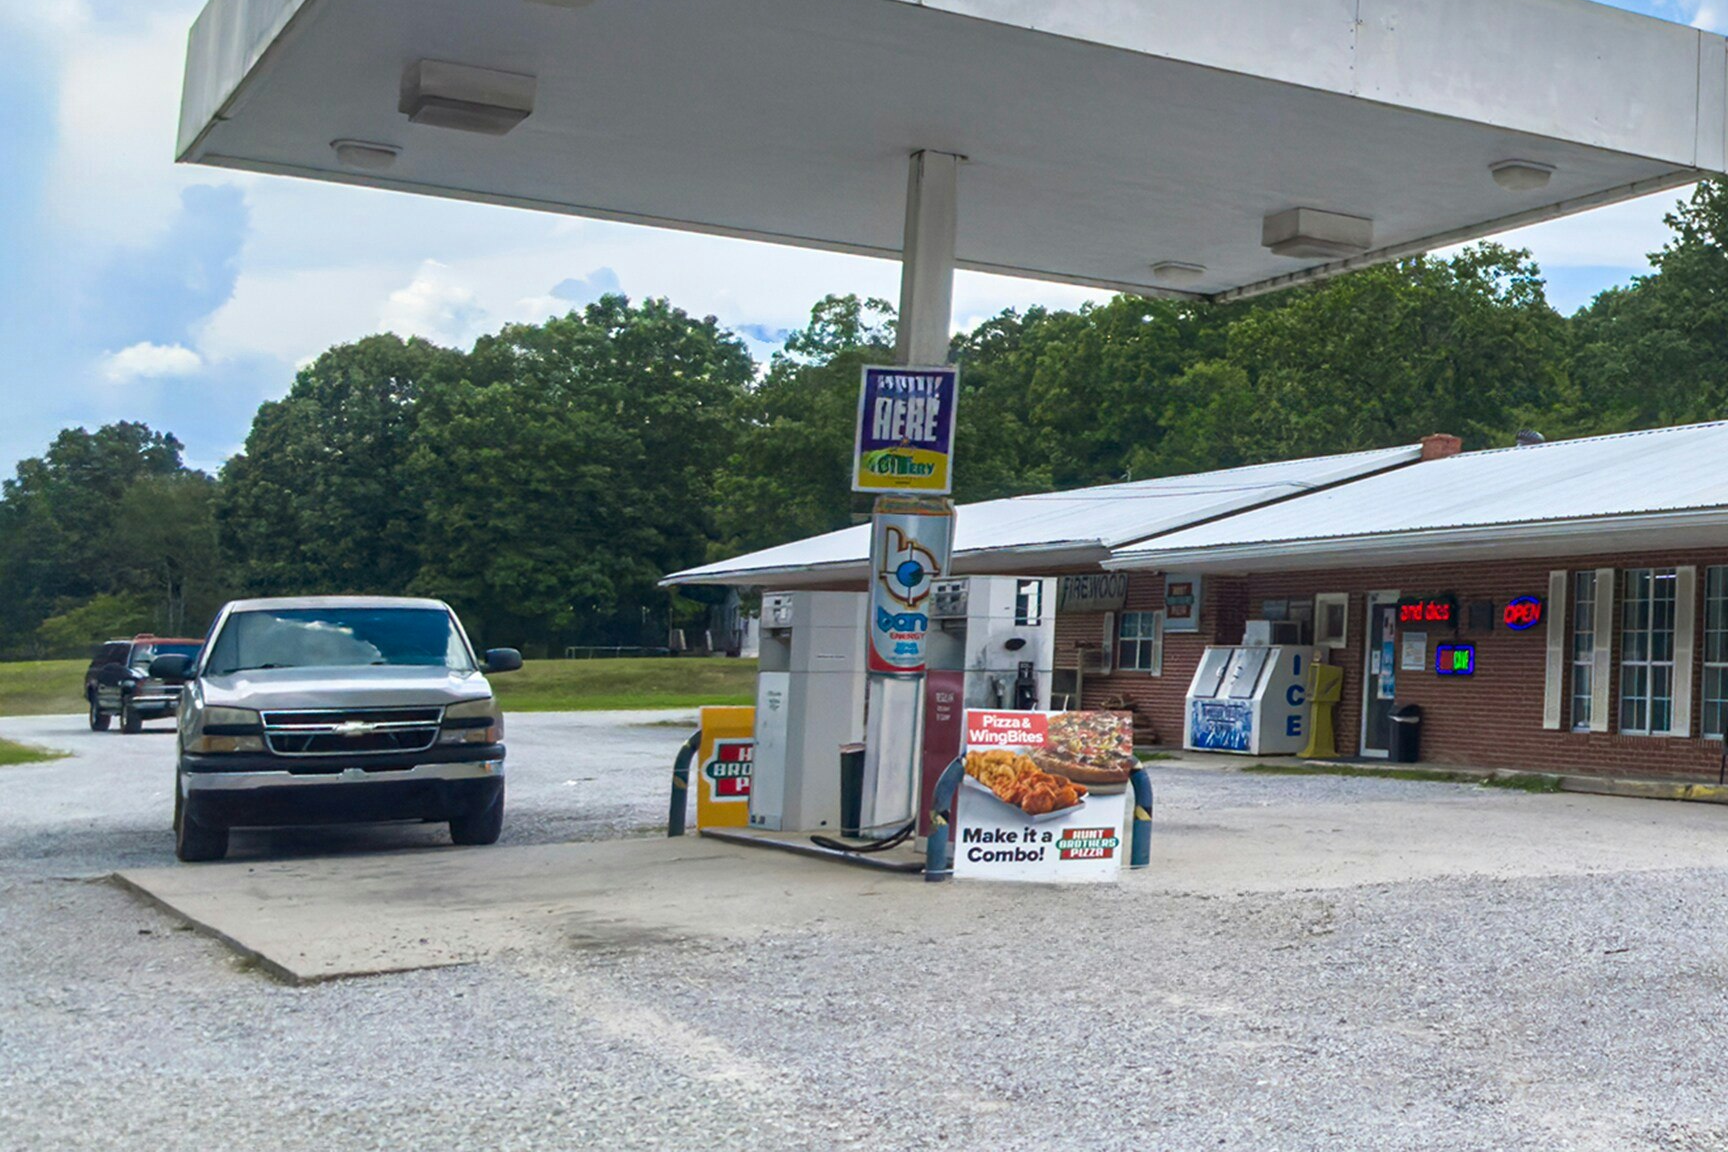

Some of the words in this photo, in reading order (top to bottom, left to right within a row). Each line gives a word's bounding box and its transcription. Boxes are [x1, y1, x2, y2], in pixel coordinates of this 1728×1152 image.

[1063, 574, 1127, 600] FIREWOOD
[1020, 580, 1040, 626] 1
[1504, 602, 1542, 623] OPEN
[1286, 654, 1305, 736] ICE
[982, 715, 1020, 728] Pizza
[1022, 717, 1031, 728] &
[969, 729, 1044, 745] WingBites
[962, 827, 1018, 843] Make
[1022, 826, 1037, 843] it
[1041, 830, 1053, 843] a
[1072, 829, 1104, 839] HUNT
[1059, 838, 1117, 849] BROTHERS
[967, 846, 1045, 863] Combo!
[1070, 848, 1104, 858] PIZZA
